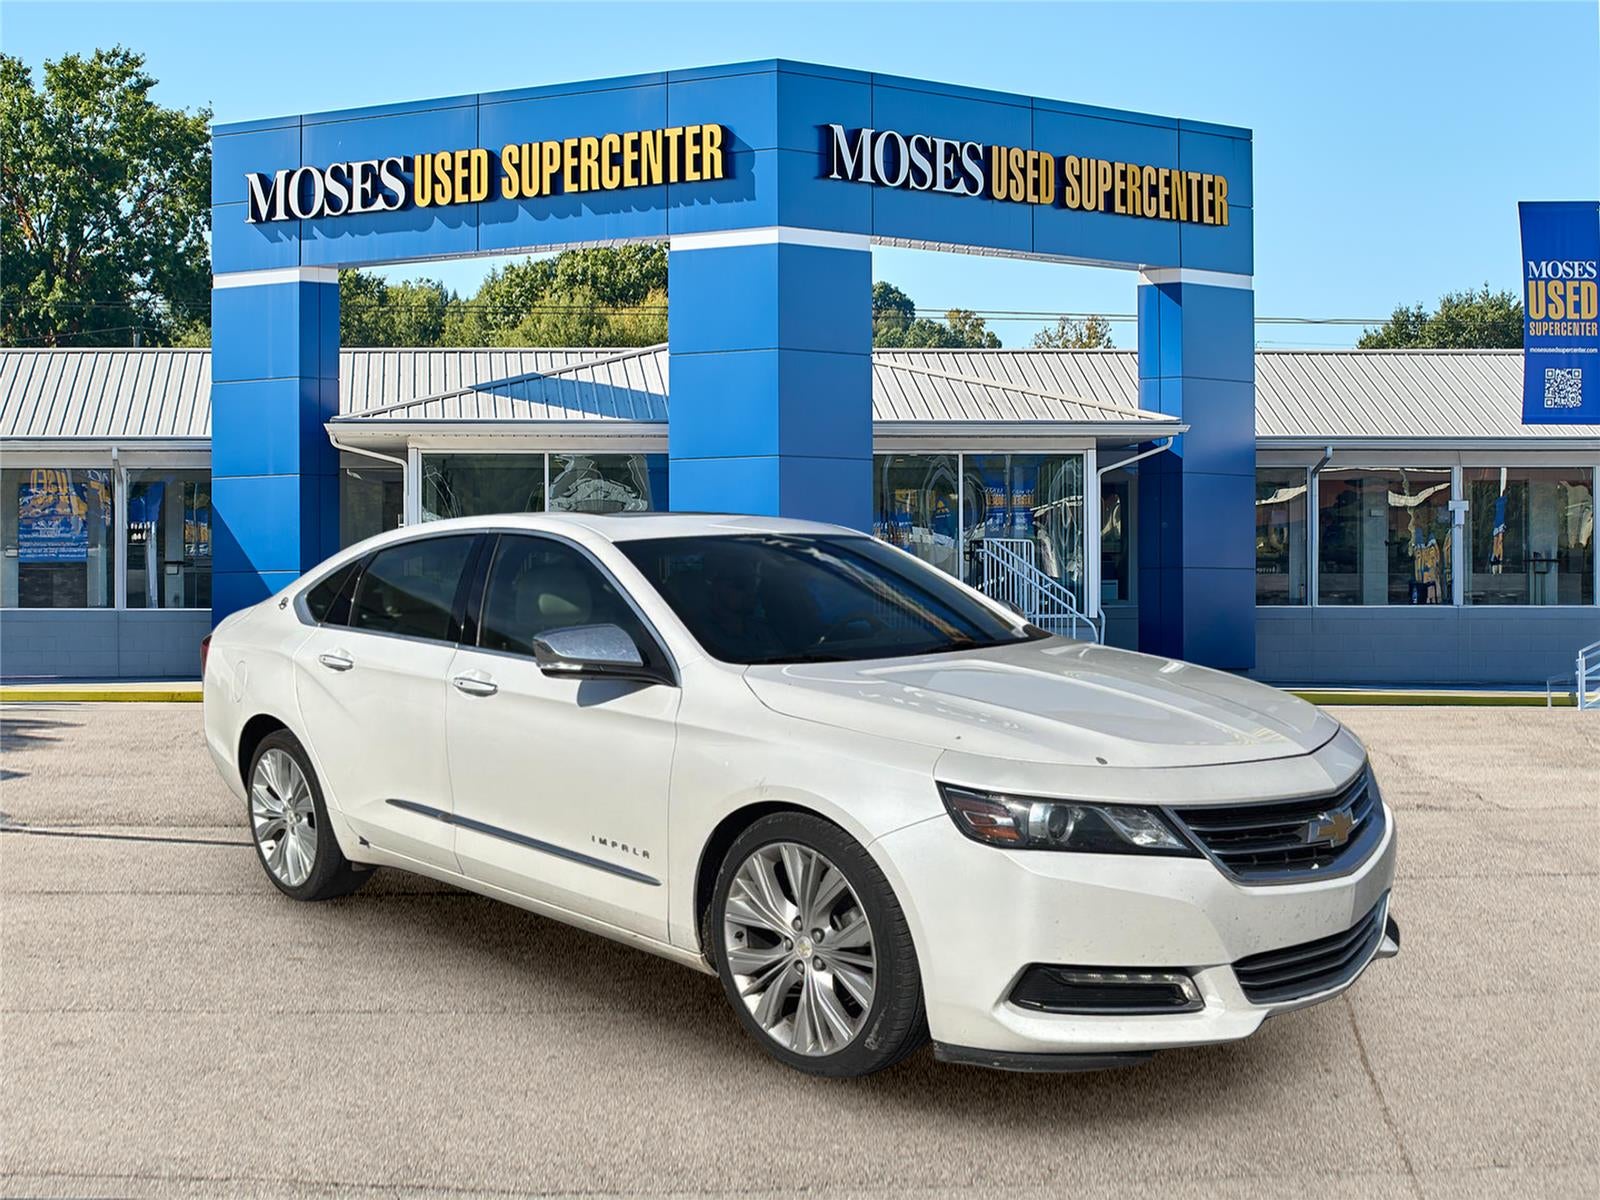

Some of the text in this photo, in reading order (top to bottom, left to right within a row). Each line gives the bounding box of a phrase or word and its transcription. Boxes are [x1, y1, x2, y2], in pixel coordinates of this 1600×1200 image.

[244, 124, 724, 224] MOSES USED SUPERCENTER
[829, 124, 1229, 226] MOSES USED SUPERCENTER
[1528, 260, 1597, 279] MOSES
[1528, 280, 1598, 320] USED
[1529, 321, 1598, 336] SUPERCENTER
[591, 835, 650, 860] IMPALA
